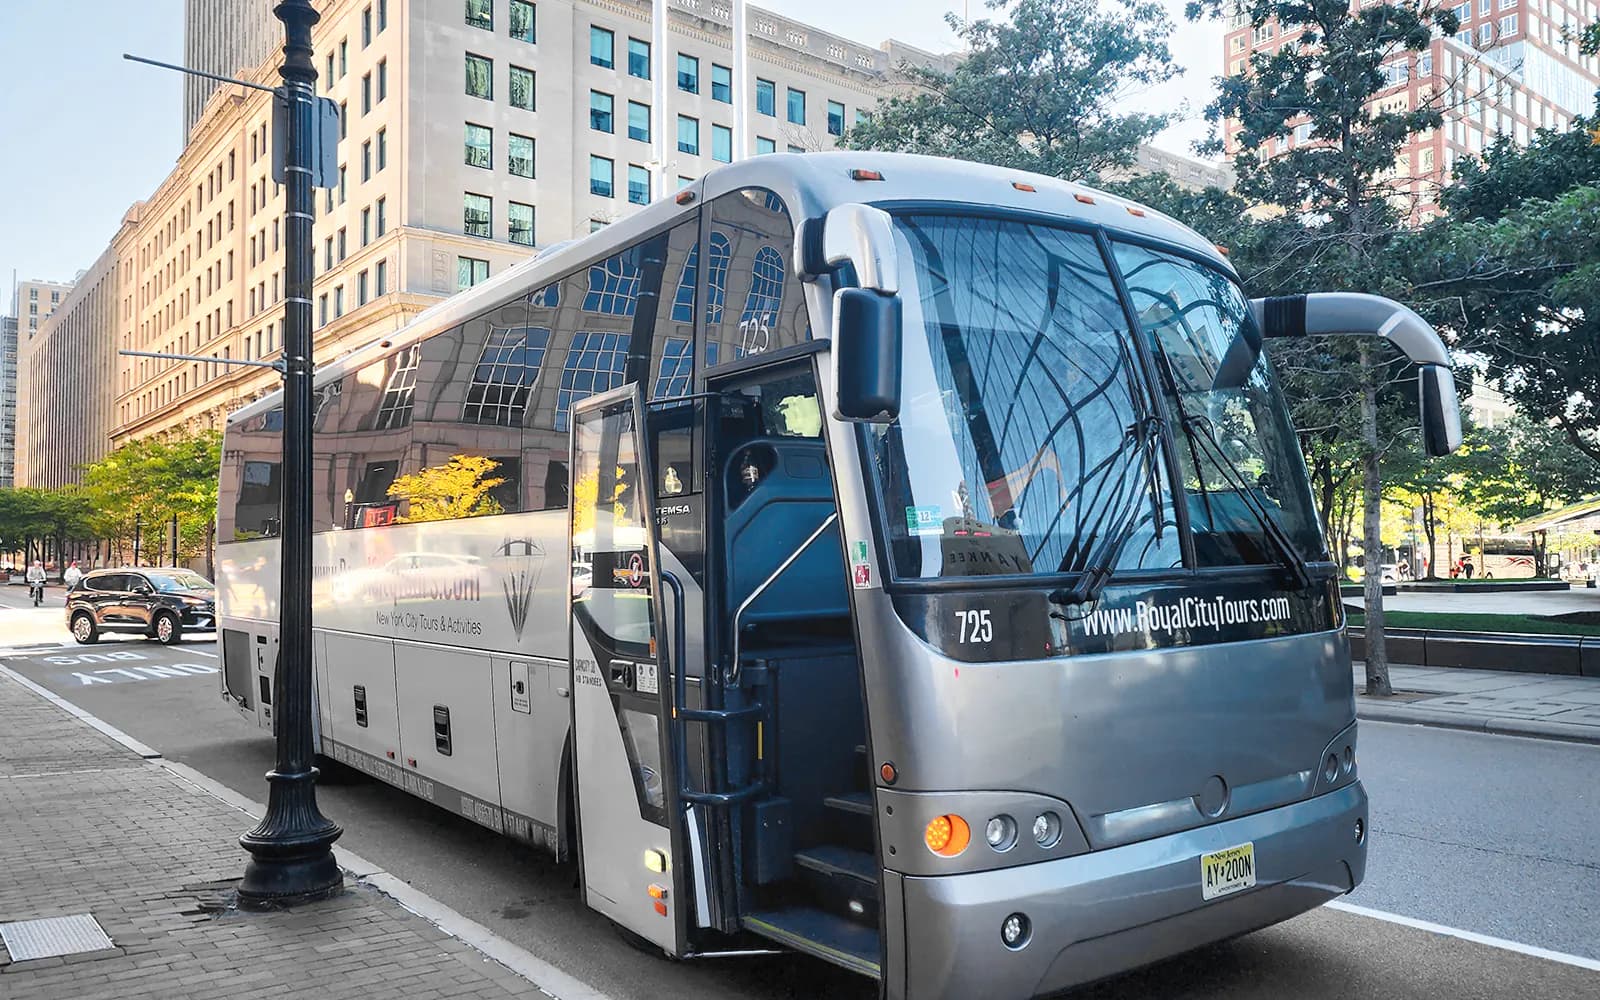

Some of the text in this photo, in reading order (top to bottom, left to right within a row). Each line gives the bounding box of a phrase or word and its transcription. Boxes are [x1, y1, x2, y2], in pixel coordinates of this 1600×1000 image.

[740, 312, 769, 358] 725
[656, 504, 691, 515] TEMSA
[376, 610, 482, 635] New York City Tours & Activities
[955, 610, 993, 643] 725
[1082, 596, 1291, 637] www.RoyalCityTours.com
[43, 651, 148, 665] BUS
[72, 663, 220, 685] ONLY
